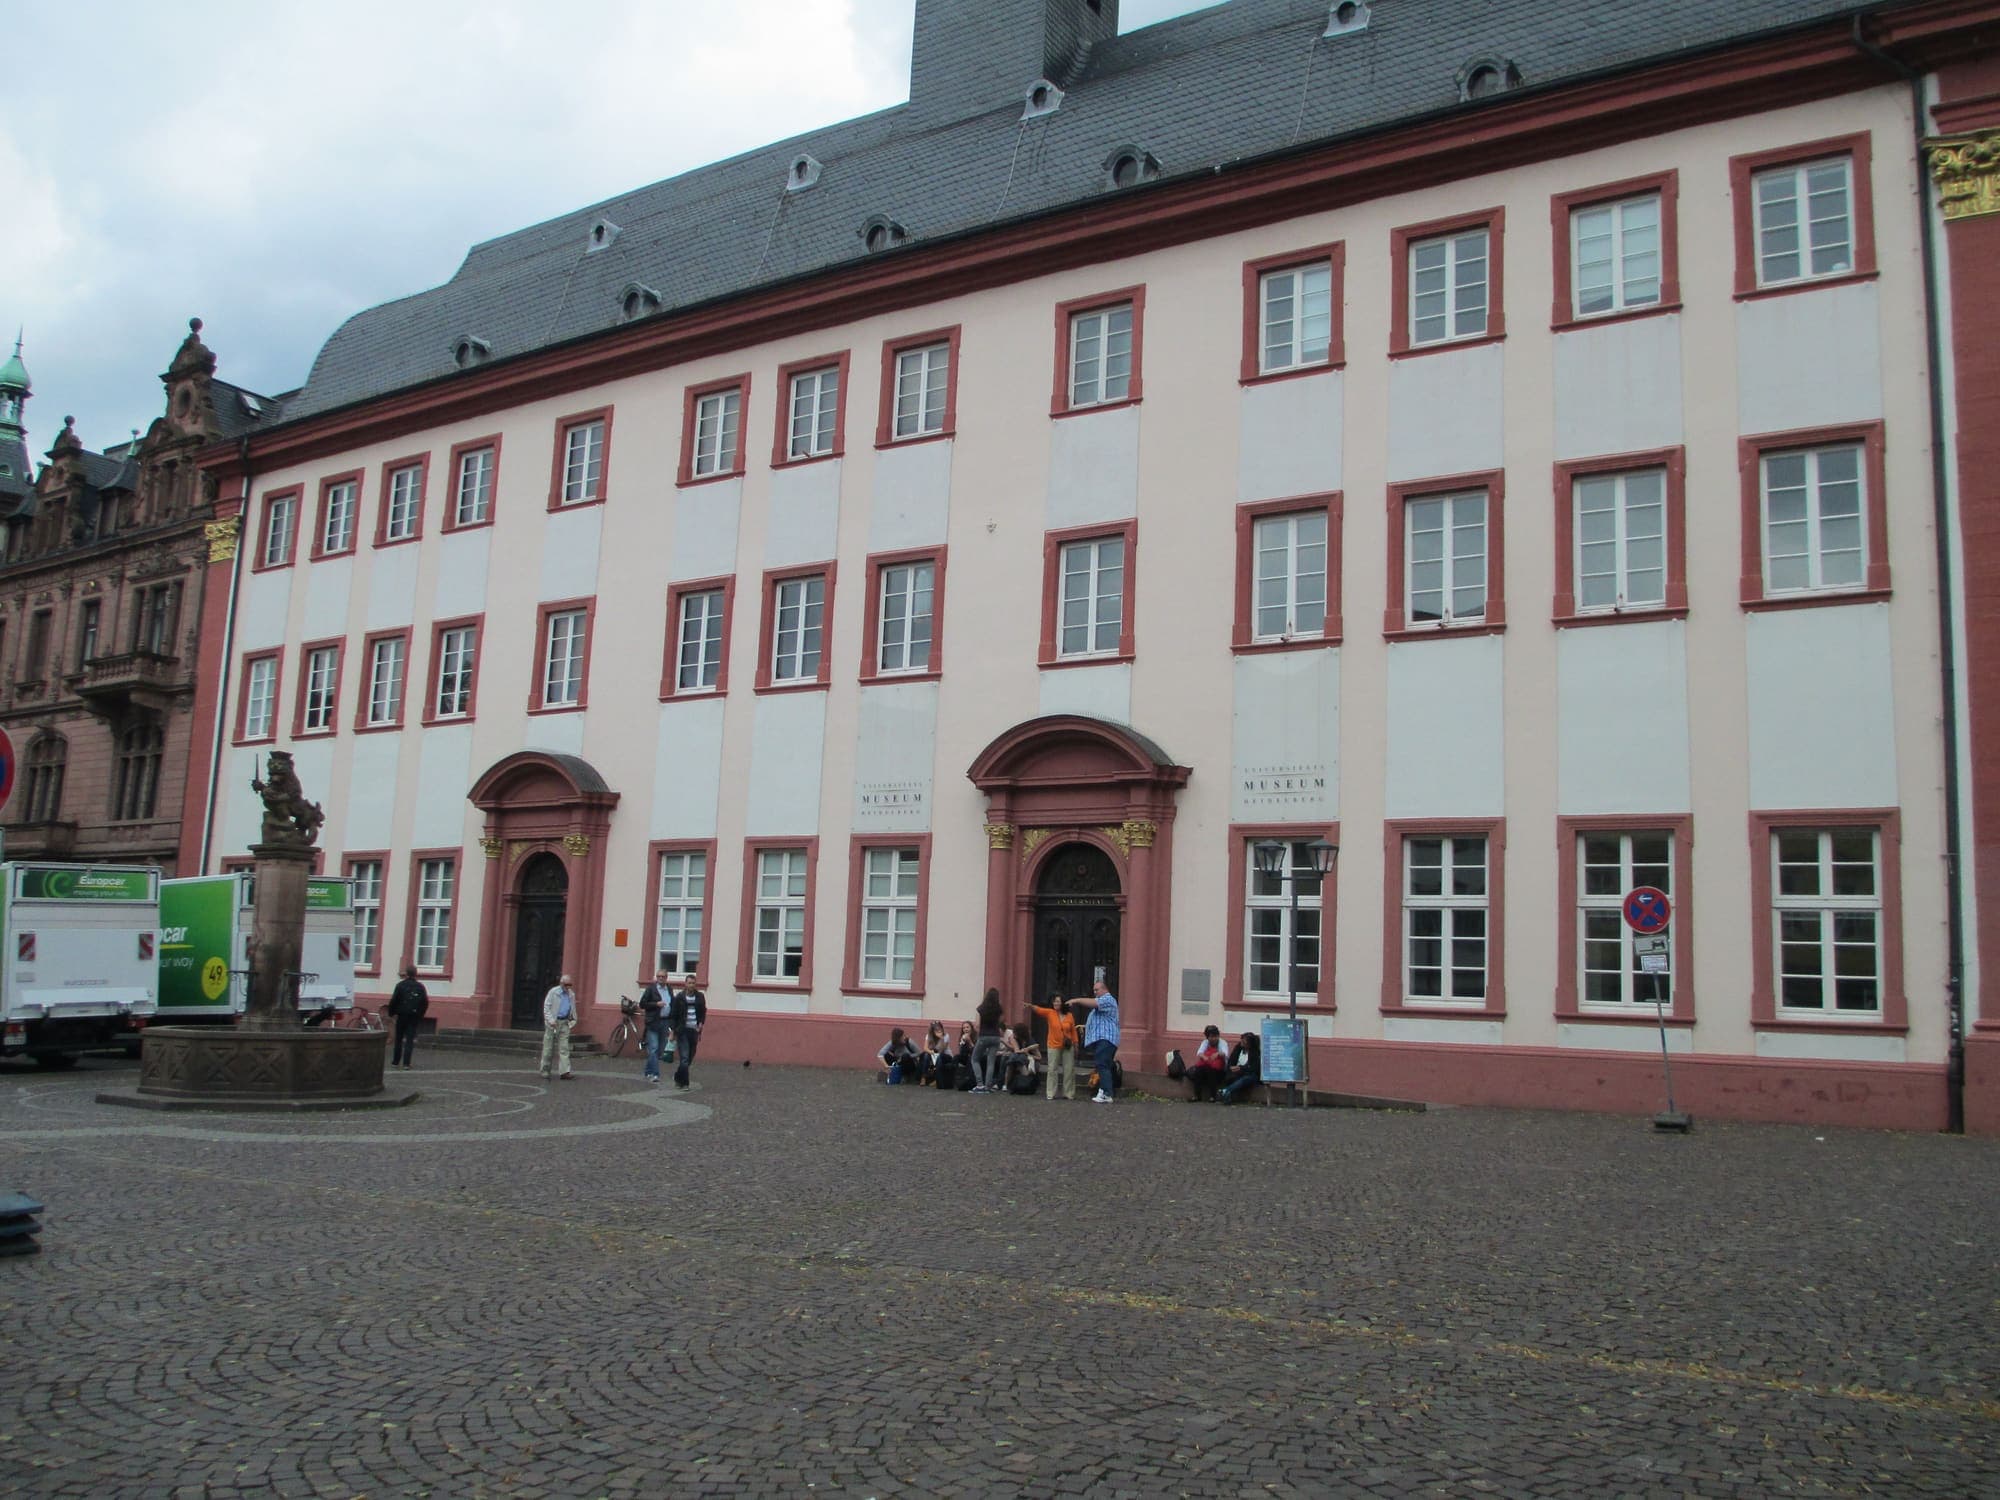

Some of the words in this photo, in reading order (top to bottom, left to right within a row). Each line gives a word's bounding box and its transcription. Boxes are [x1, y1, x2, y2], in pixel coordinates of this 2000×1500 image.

[1243, 778, 1324, 790] MUSEUM
[862, 793, 921, 803] MUSEUM
[79, 875, 126, 887] Europcar
[209, 965, 223, 981] 49
